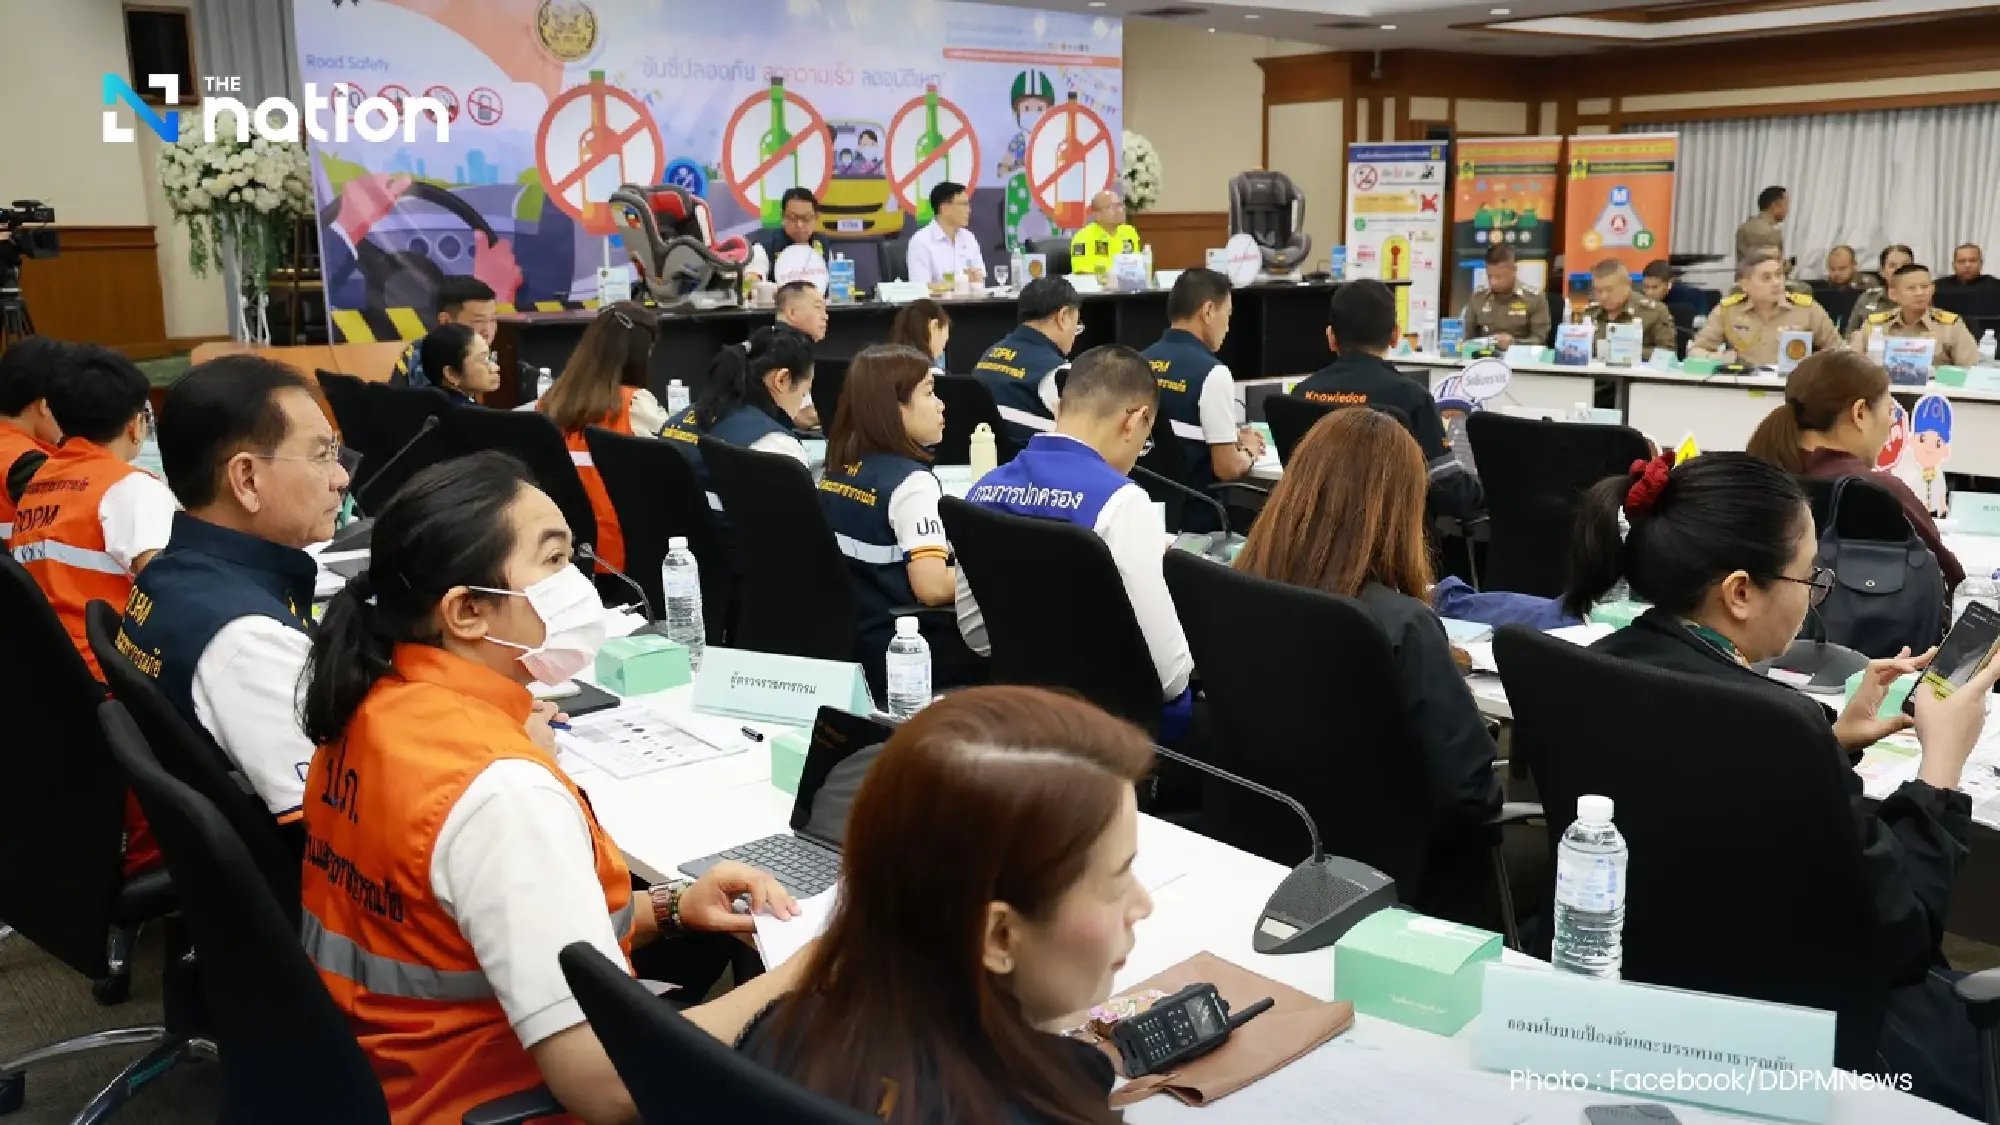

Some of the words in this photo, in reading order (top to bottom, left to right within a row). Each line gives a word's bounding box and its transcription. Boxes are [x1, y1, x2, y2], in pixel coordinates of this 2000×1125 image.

[306, 53, 345, 70] Road
[347, 56, 390, 73] Safety
[1305, 390, 1367, 404] Knowledge
[970, 481, 1084, 510] กรมการปกครอง
